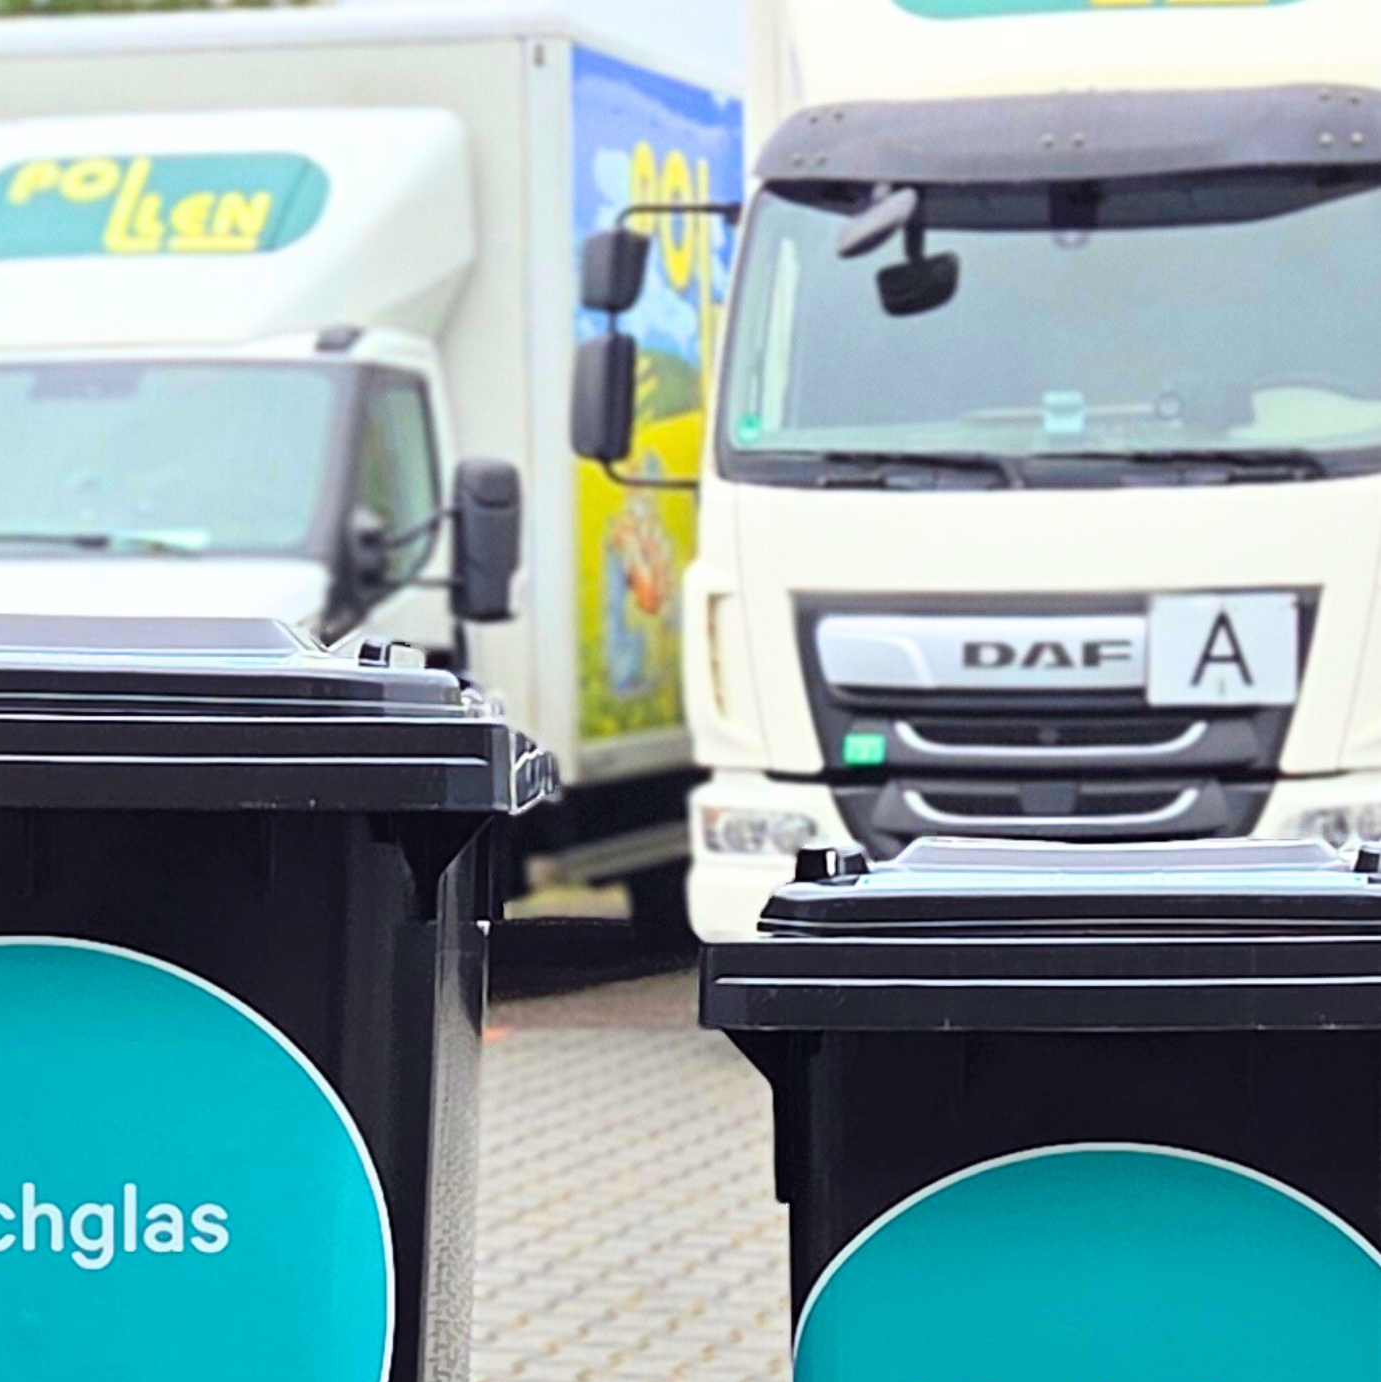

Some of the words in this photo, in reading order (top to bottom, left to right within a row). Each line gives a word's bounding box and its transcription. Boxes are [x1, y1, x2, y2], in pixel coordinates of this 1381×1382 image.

[8, 155, 272, 254] POLLEN
[962, 640, 1133, 669] DAF
[1189, 607, 1256, 686] A
